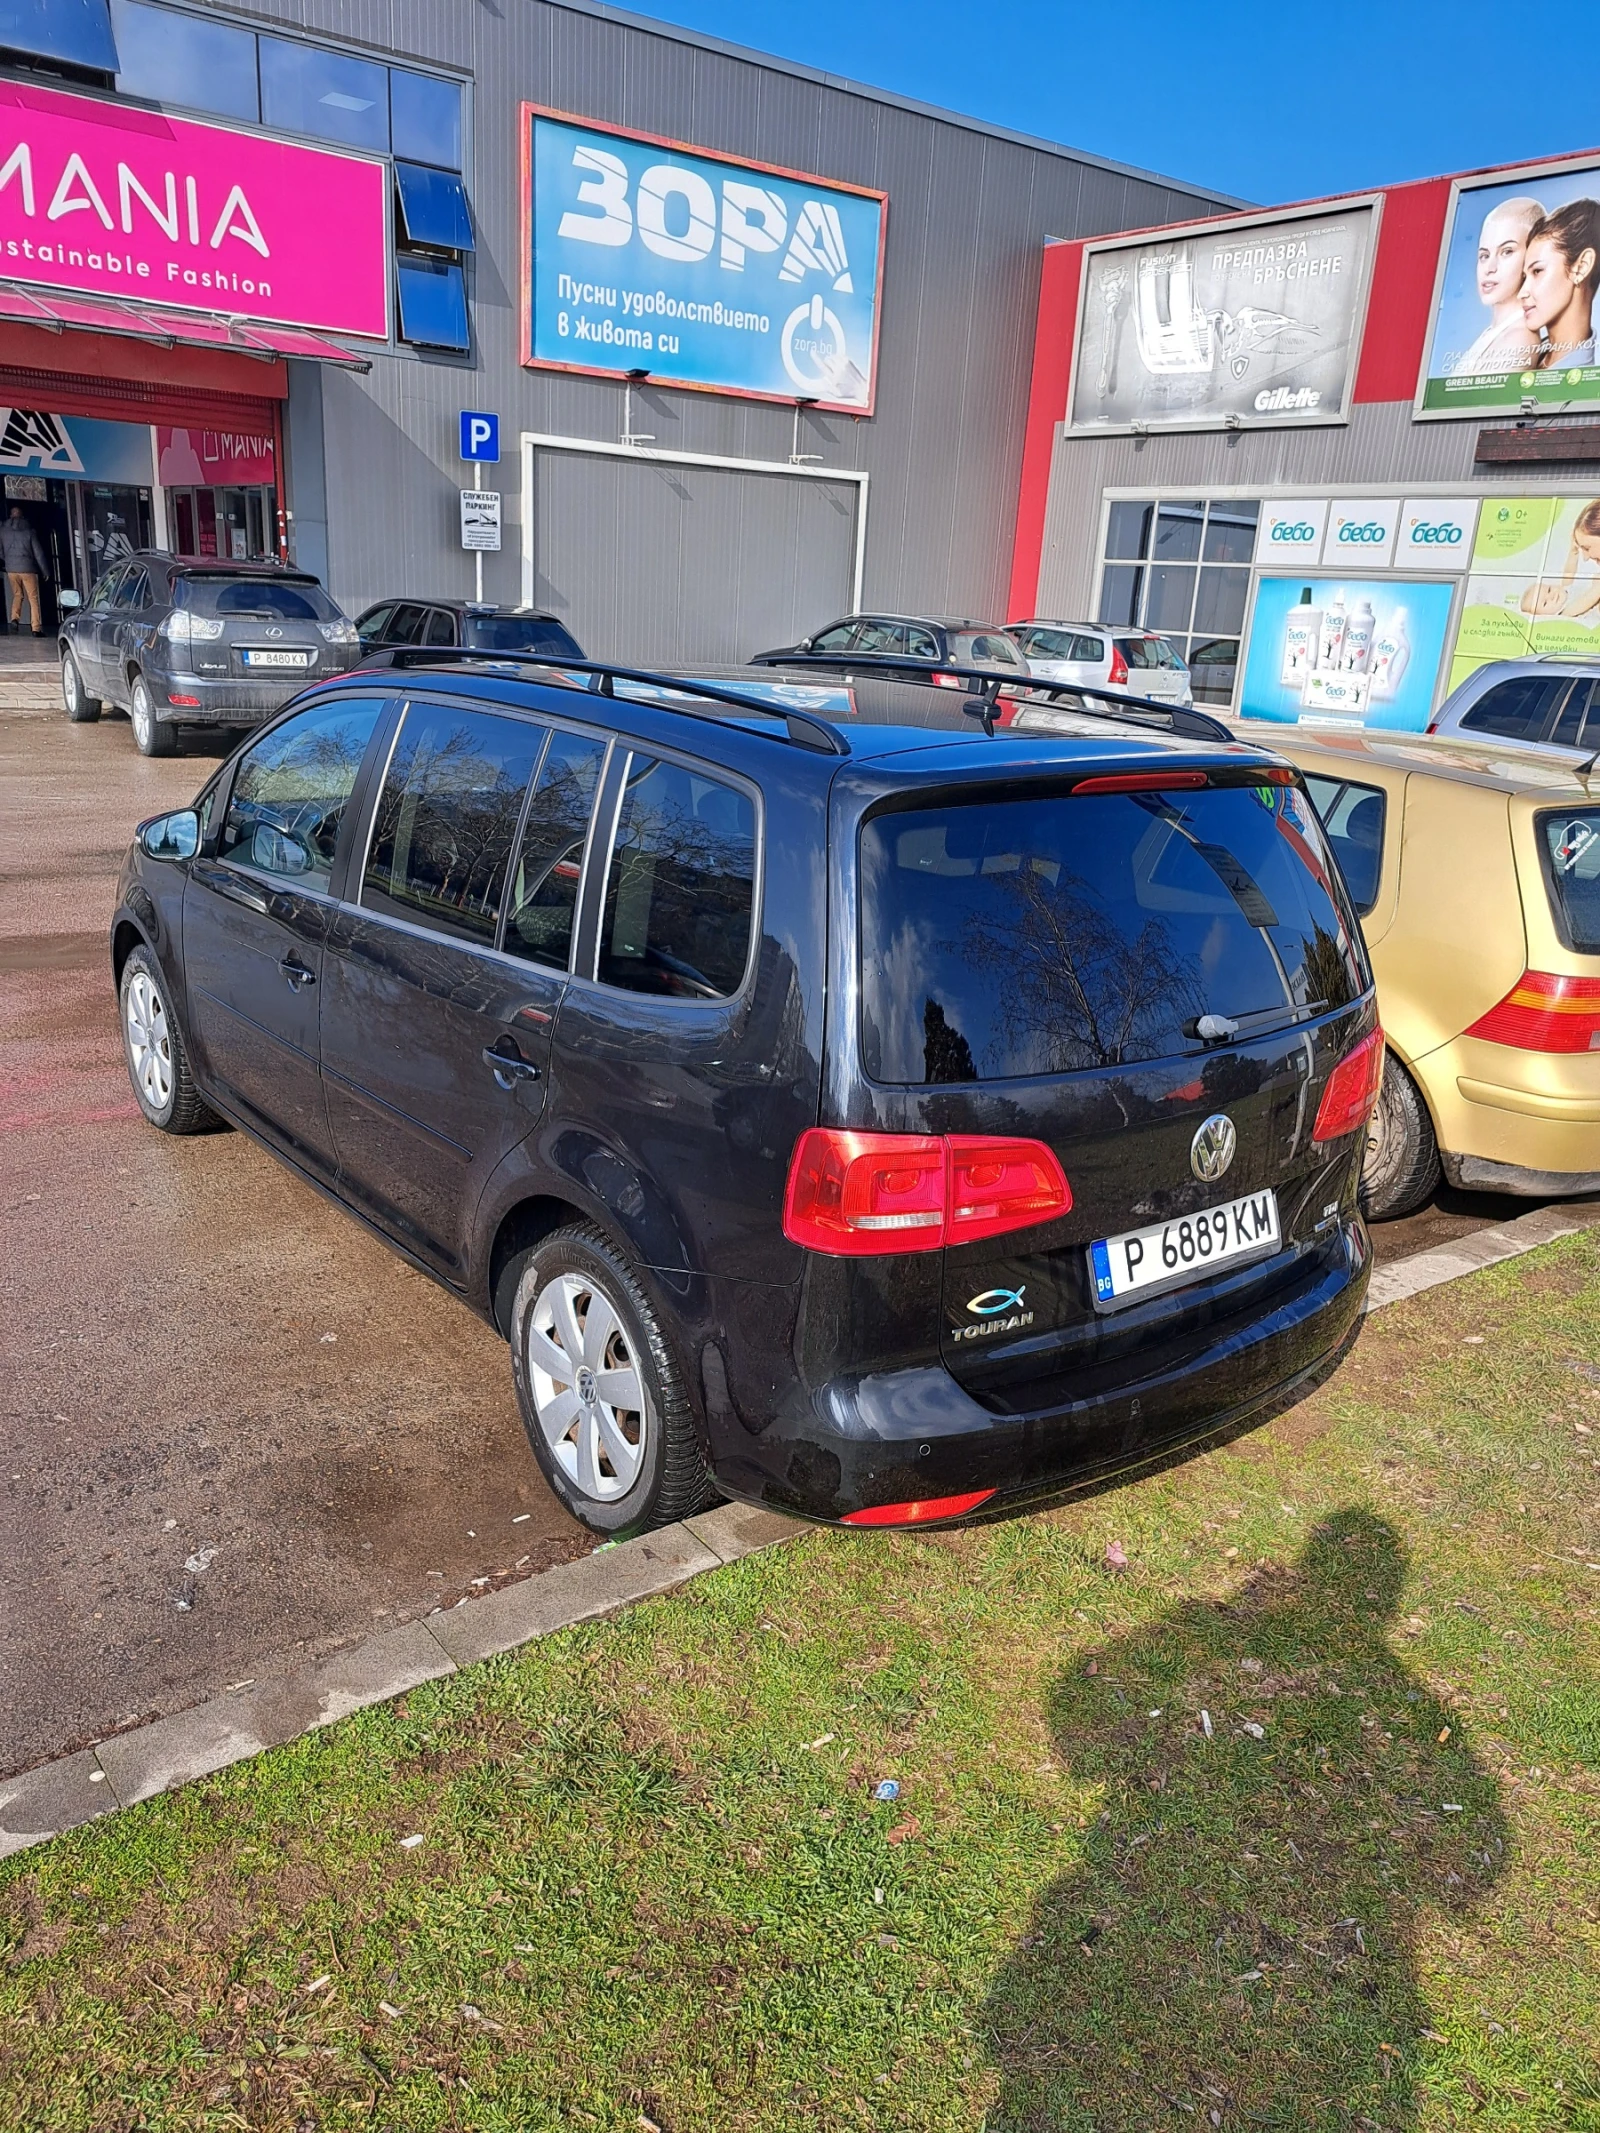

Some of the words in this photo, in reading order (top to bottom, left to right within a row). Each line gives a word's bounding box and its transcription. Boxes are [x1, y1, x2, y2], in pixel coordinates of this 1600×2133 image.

[557, 145, 854, 294] ЗОРА
[1212, 241, 1308, 270] ПРЕДПАЗВА
[166, 262, 272, 298] Fashion
[1254, 256, 1342, 284] БРЪСНЕНЕ
[558, 273, 617, 306] Пусни
[622, 290, 770, 333] удоволствието
[557, 311, 569, 337] в
[574, 315, 653, 350] живота
[658, 333, 680, 354] си
[794, 338, 833, 358] zora.bg
[1496, 341, 1574, 356] ХИДРАТИРАНА
[1479, 357, 1532, 371] УПОТРЕБА
[1445, 375, 1475, 388] GREEN
[1476, 374, 1510, 386] BEAUTY
[1254, 386, 1320, 411] Gillette
[471, 418, 491, 453] P
[463, 492, 499, 502] СЛУЖЕБЕН
[465, 502, 496, 511] ПАРКИНГ
[1515, 509, 1528, 520] 0+
[1271, 521, 1315, 542] бебо
[1338, 522, 1386, 543] бебо
[1411, 522, 1463, 544] бебо
[1536, 633, 1565, 643] винаги
[1566, 634, 1600, 645] готови
[1097, 1276, 1112, 1292] BG
[952, 1311, 1034, 1342] TOURAN
